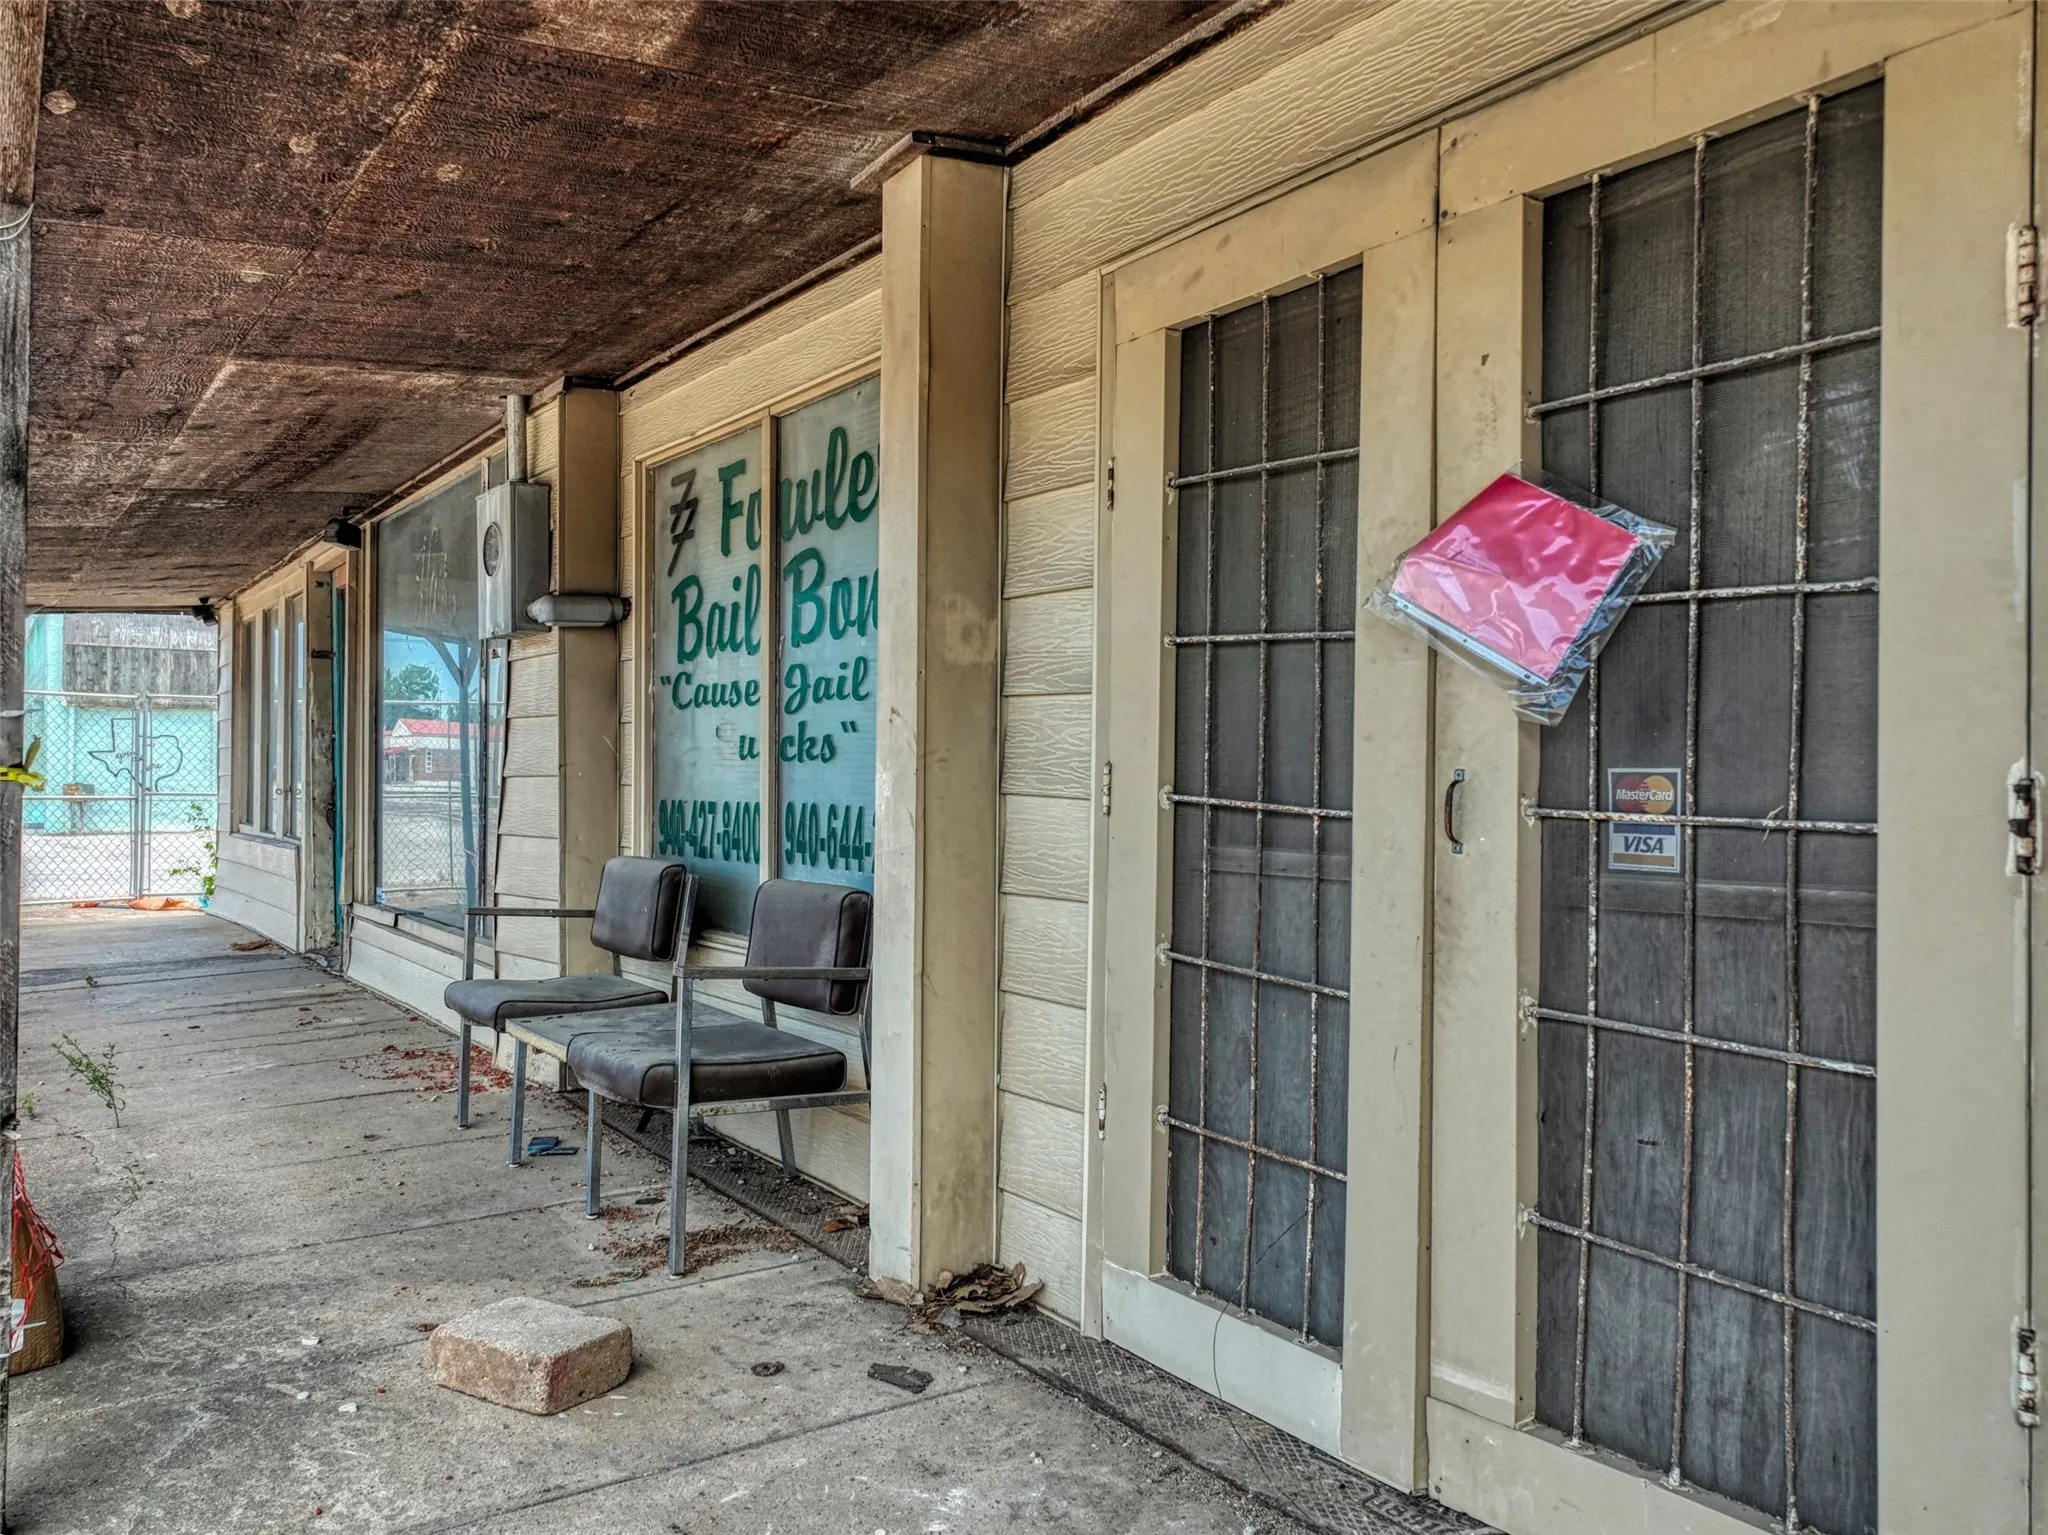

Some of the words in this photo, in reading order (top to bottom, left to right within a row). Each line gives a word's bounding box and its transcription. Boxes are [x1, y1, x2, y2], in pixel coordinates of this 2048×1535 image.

[717, 426, 880, 557] Fowle
[671, 563, 761, 664] Bail
[783, 547, 879, 648] Bon
[660, 671, 761, 710] "Cause
[784, 656, 870, 715] Jail
[716, 720, 858, 764] ucks"
[1615, 788, 1675, 801] MasterCard
[658, 799, 761, 865] 940-427-8400
[784, 801, 876, 874] 940-644-
[1622, 835, 1667, 854] VISA
